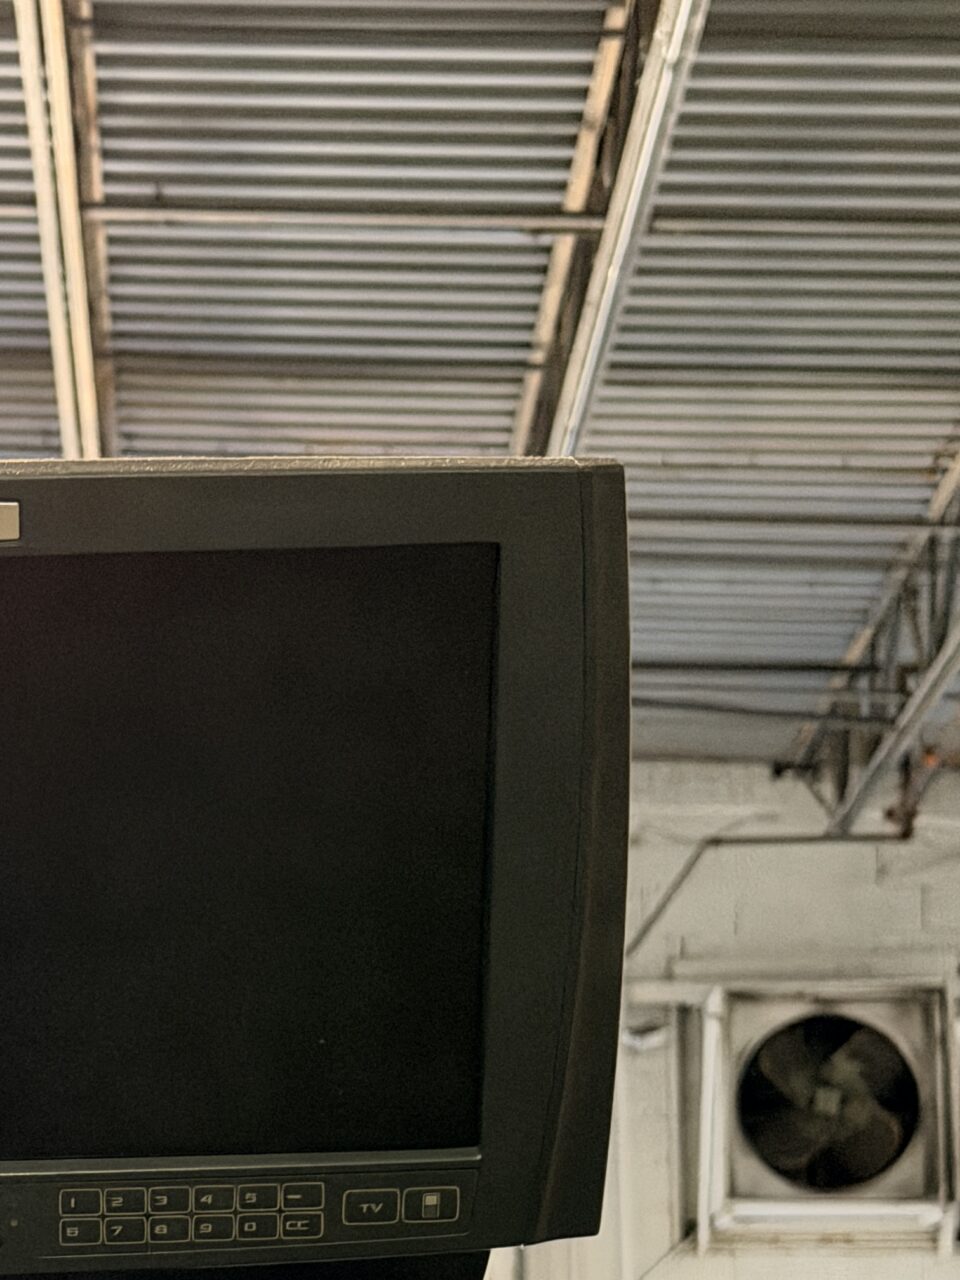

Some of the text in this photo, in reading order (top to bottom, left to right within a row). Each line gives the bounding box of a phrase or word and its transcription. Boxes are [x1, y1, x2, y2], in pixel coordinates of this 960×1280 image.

[154, 1195, 168, 1206] 3
[200, 1194, 213, 1205] 4
[245, 1192, 257, 1203] 5
[359, 1203, 383, 1213] TV
[111, 1226, 123, 1236] 7
[154, 1224, 168, 1235] 8
[199, 1223, 212, 1233] 9
